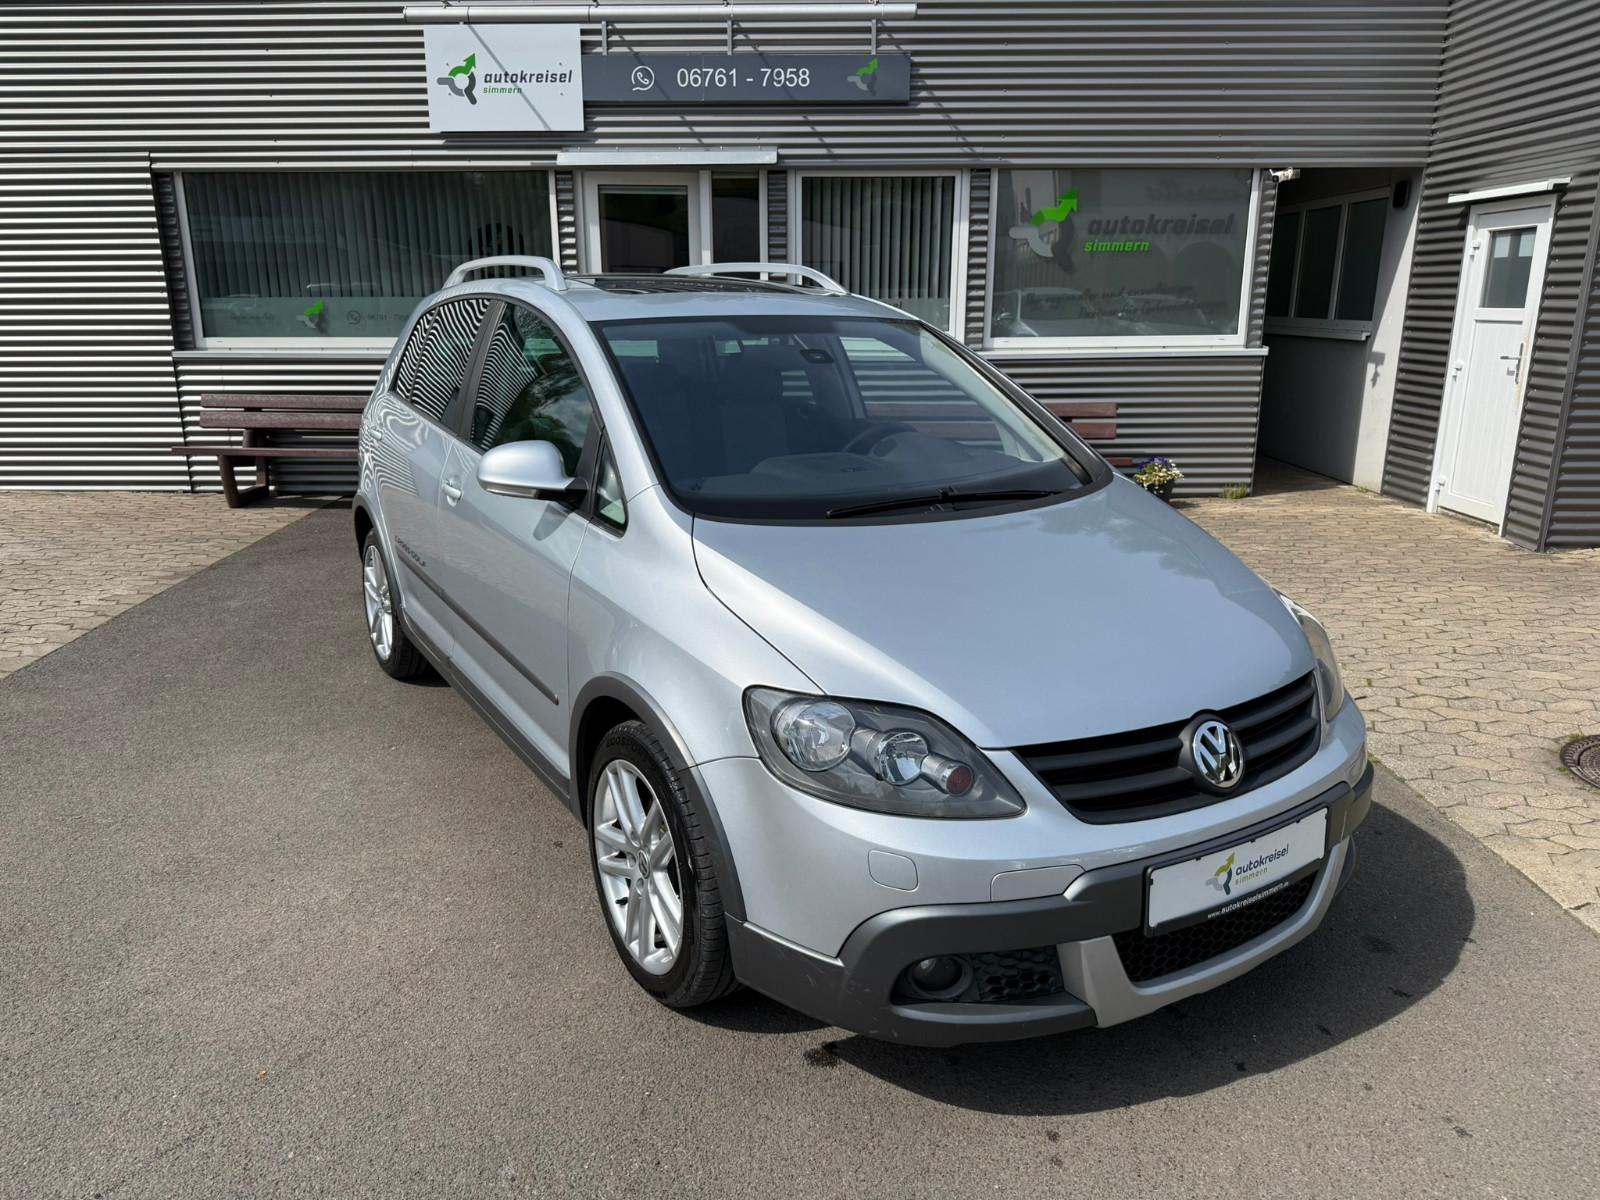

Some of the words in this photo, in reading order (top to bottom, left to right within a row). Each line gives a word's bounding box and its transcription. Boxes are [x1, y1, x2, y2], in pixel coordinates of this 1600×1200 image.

[484, 69, 573, 84] autokreisel
[676, 68, 738, 88] 06761
[760, 68, 811, 88] 7958
[483, 86, 523, 94] simmern
[1087, 213, 1236, 236] autokreisel
[1084, 240, 1150, 253] simmern
[1235, 843, 1289, 876] autokreisel
[1235, 867, 1268, 885] simmern
